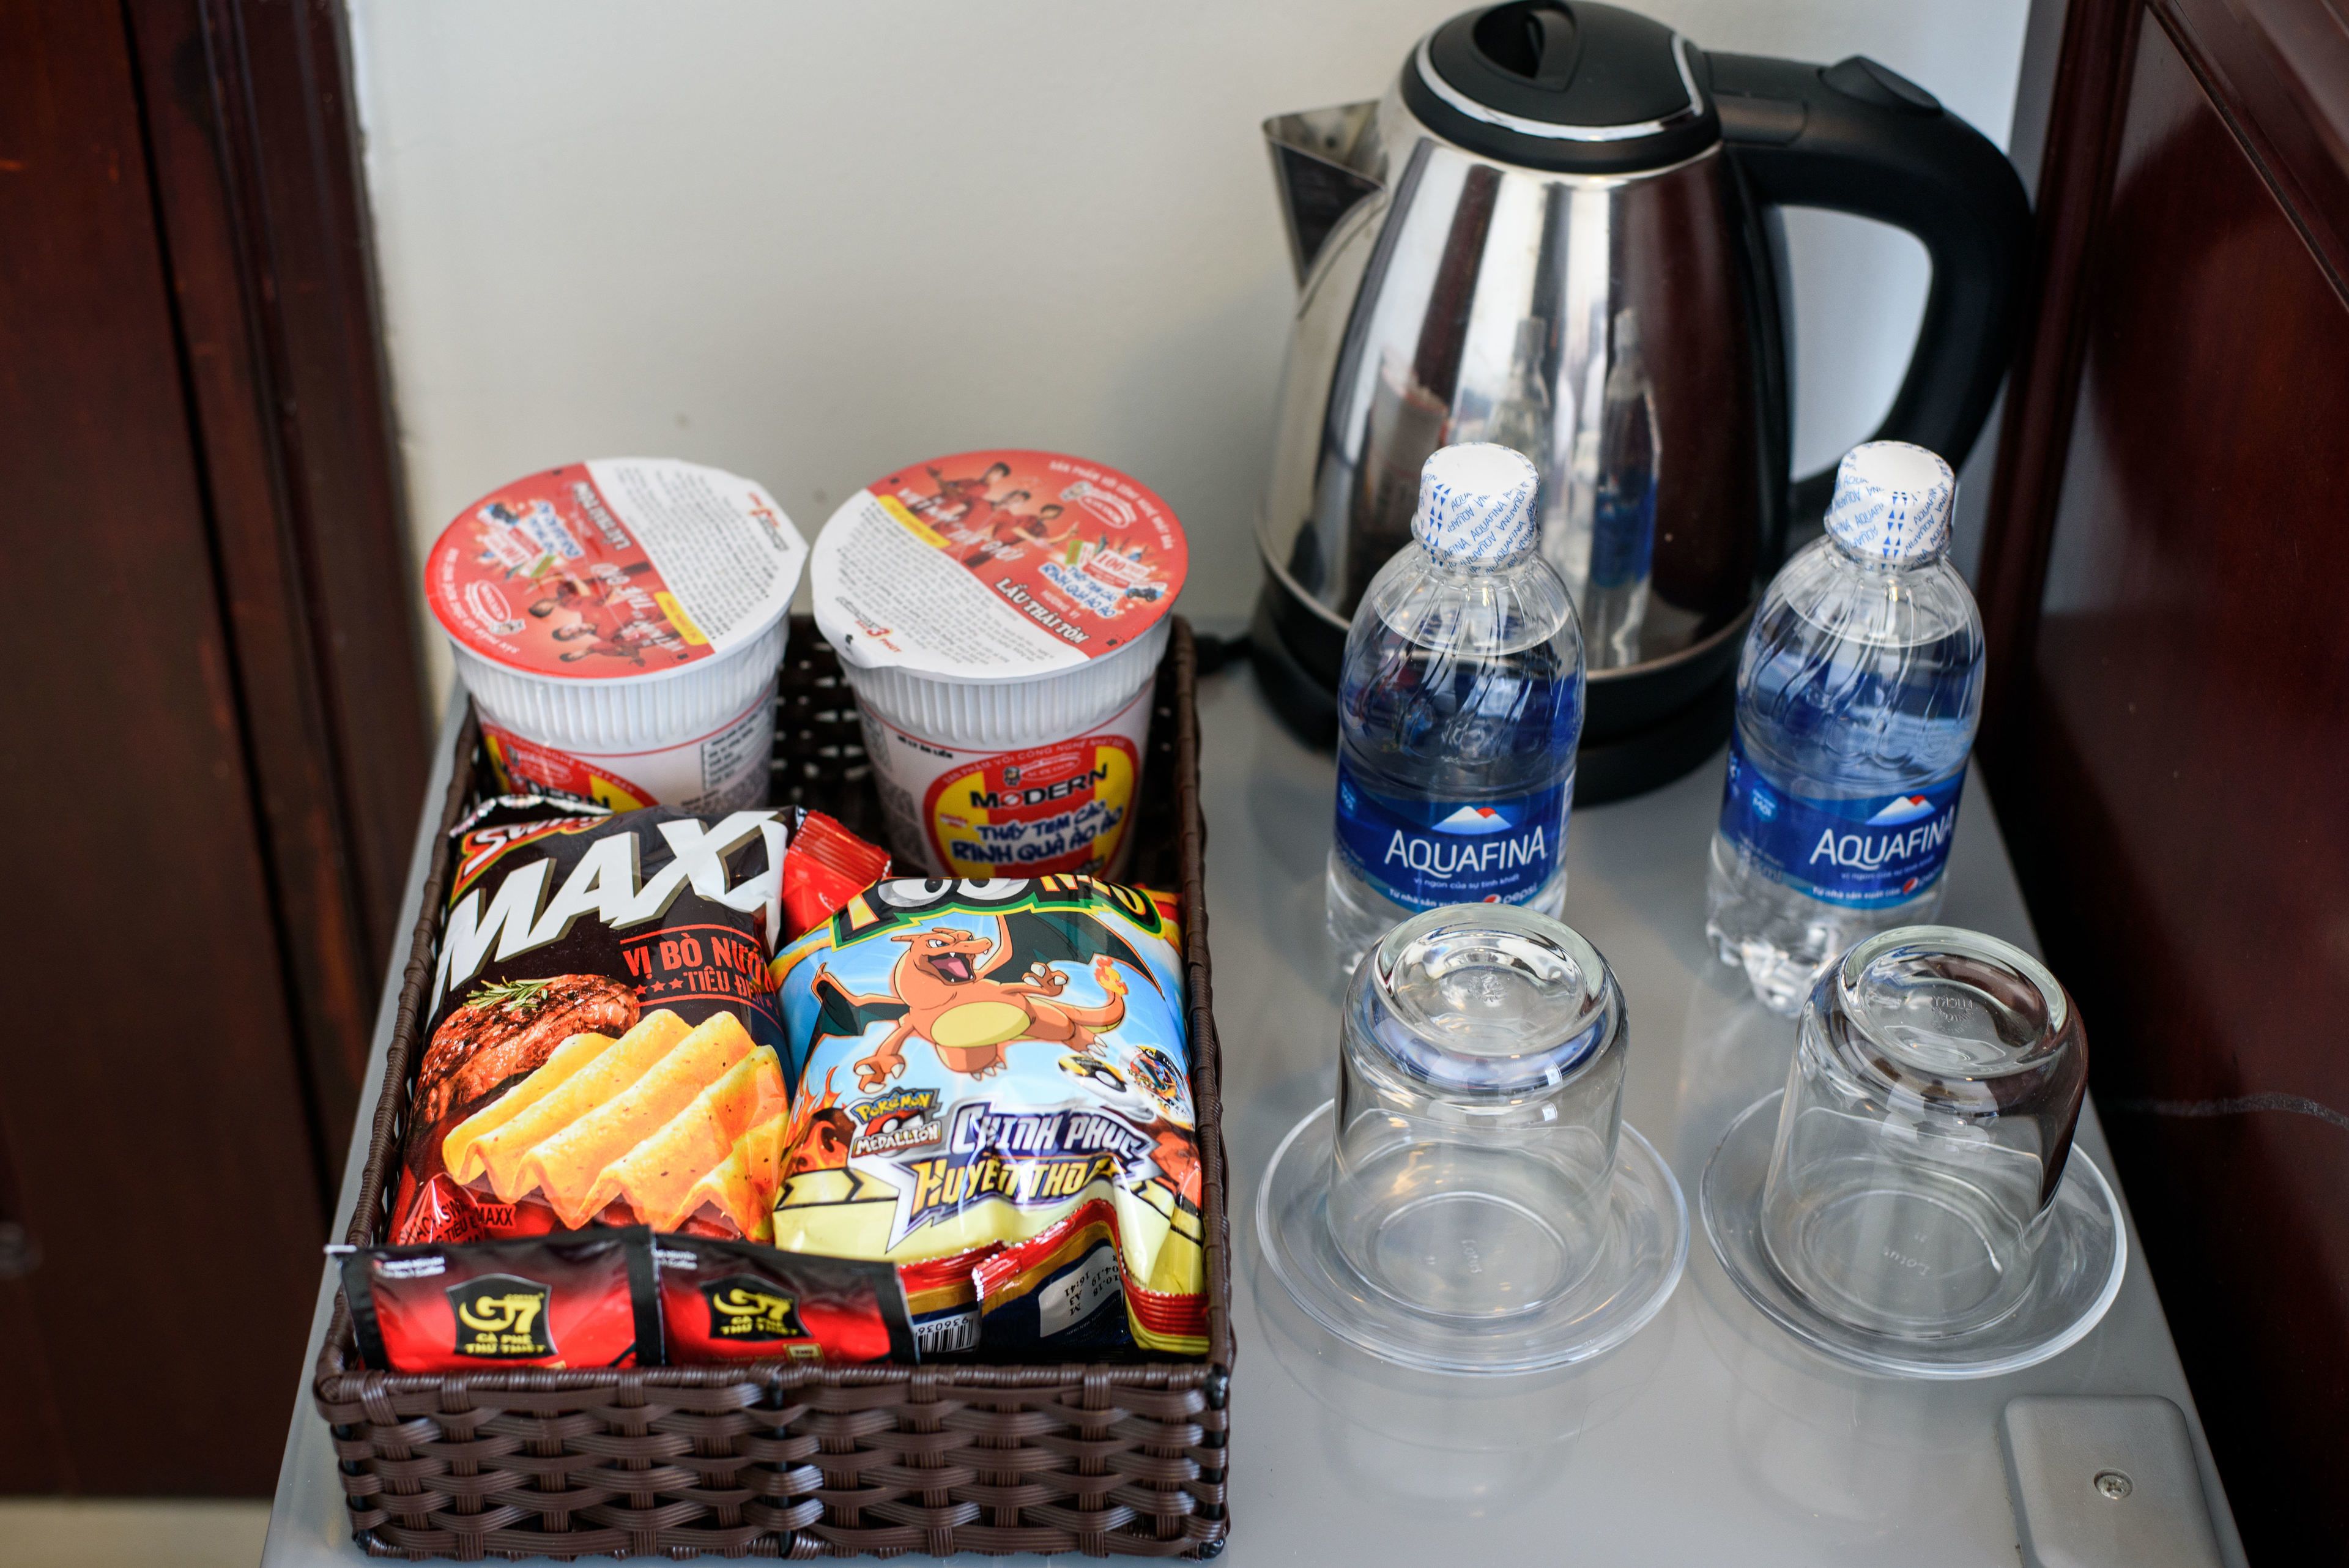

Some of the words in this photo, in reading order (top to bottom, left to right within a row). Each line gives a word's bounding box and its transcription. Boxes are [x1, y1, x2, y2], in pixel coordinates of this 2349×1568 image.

[1471, 500, 1507, 541] AQUAFINA
[866, 627, 891, 637] 3
[1055, 623, 1091, 644] TÔM
[970, 762, 1108, 809] MODERN
[1031, 814, 1071, 837] TEM
[1809, 804, 1956, 871] AQUAFINA
[951, 841, 1014, 864] RINH
[1016, 831, 1067, 861] QUÀ
[1384, 825, 1546, 879] AQUAFINA
[1424, 880, 1448, 888] ngon
[1502, 882, 1538, 905] pepsi
[623, 946, 653, 979] VỊ
[659, 932, 703, 971] BÒ
[683, 965, 730, 992] TIÊU
[855, 1124, 938, 1155] MEDALLION
[1064, 1270, 1090, 1296] 16:41
[713, 1288, 792, 1321] G7
[1069, 1290, 1083, 1307] A3
[1069, 1302, 1082, 1317] M
[460, 1295, 541, 1334] G7
[918, 1317, 968, 1336] 936036
